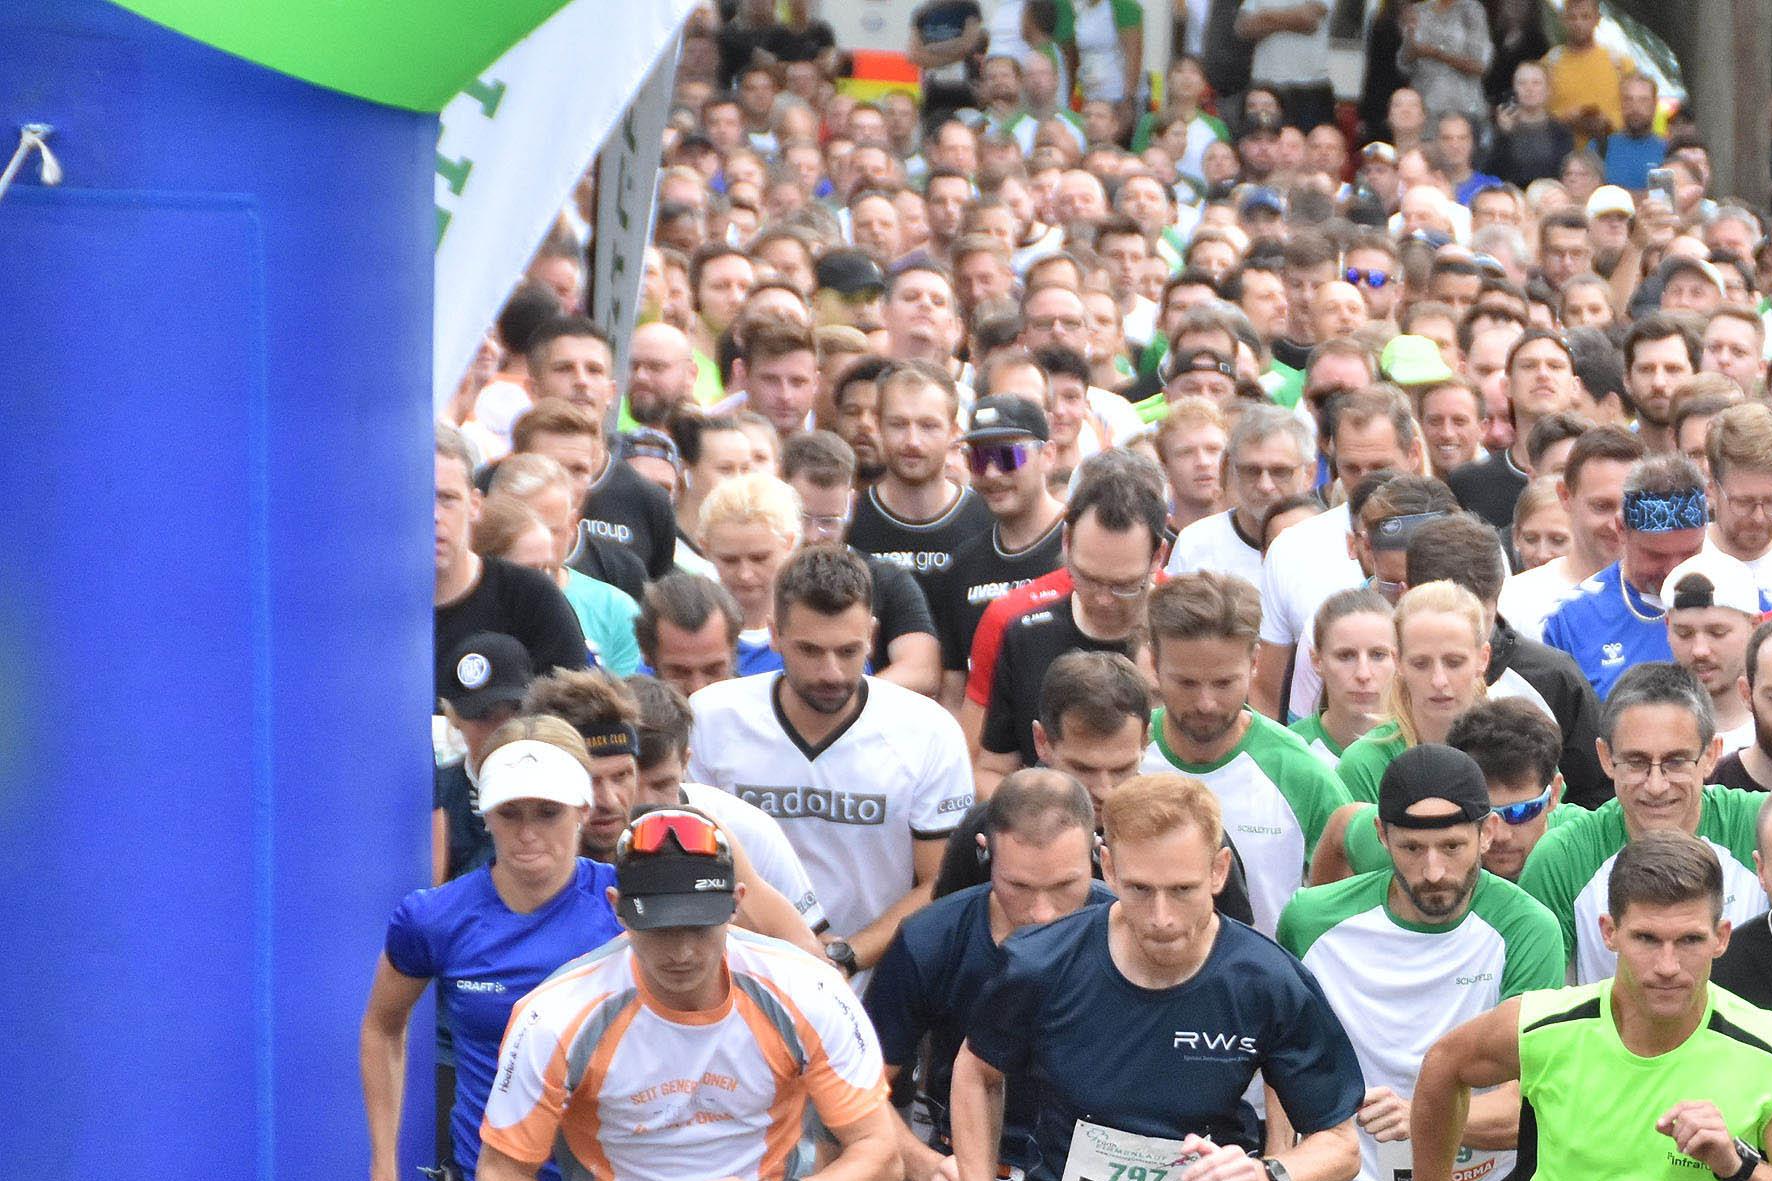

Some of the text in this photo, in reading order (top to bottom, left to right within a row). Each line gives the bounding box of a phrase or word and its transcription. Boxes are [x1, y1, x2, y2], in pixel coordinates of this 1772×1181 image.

[741, 787, 880, 821] cadolto
[695, 879, 725, 891] 2XU
[457, 980, 493, 992] CRAFT
[1173, 1032, 1257, 1054] RWS
[630, 1086, 658, 1105] SEIT
[1452, 1160, 1495, 1181] ORMA
